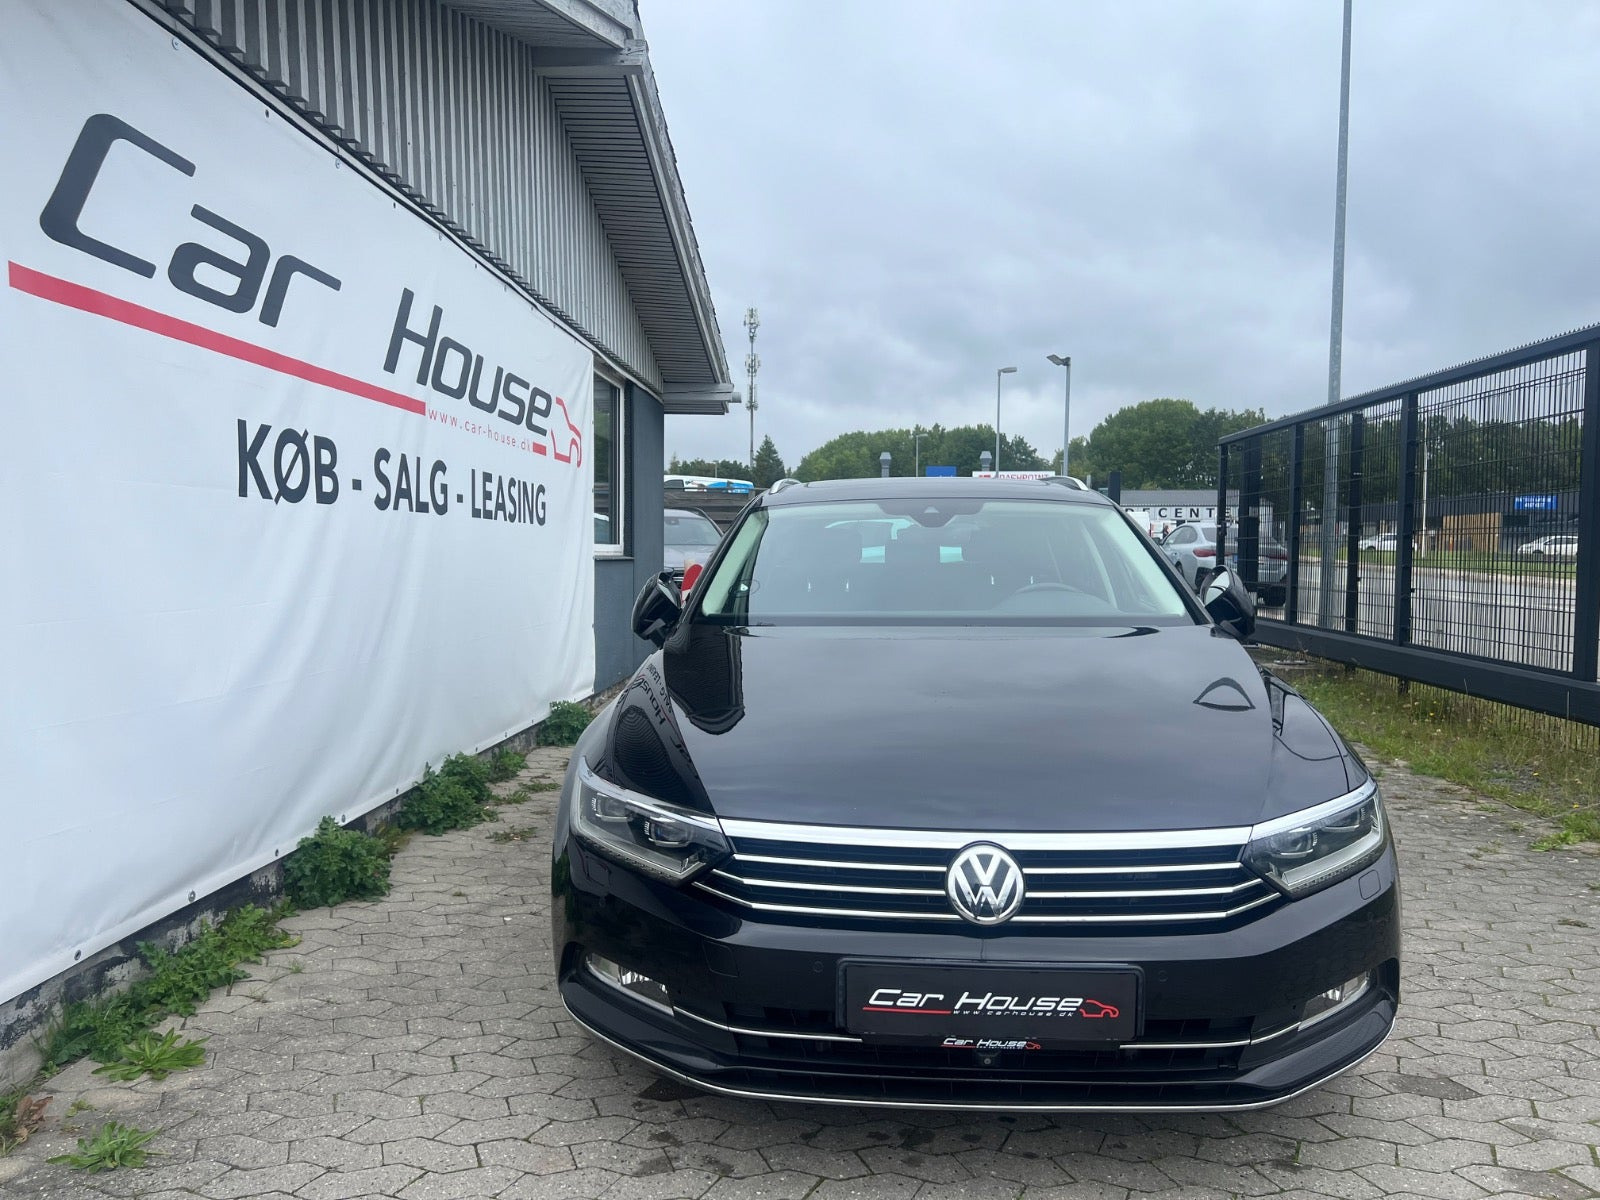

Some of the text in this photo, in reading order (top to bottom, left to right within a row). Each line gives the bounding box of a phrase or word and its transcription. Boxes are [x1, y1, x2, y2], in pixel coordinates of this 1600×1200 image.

[39, 113, 553, 437] Car House
[237, 418, 339, 505] KØB
[373, 447, 448, 515] SALG
[471, 468, 547, 526] LEASING
[868, 988, 1084, 1012] Car House
[953, 1009, 1074, 1018] www.carhouse.dk
[943, 1037, 1027, 1048] Car House
